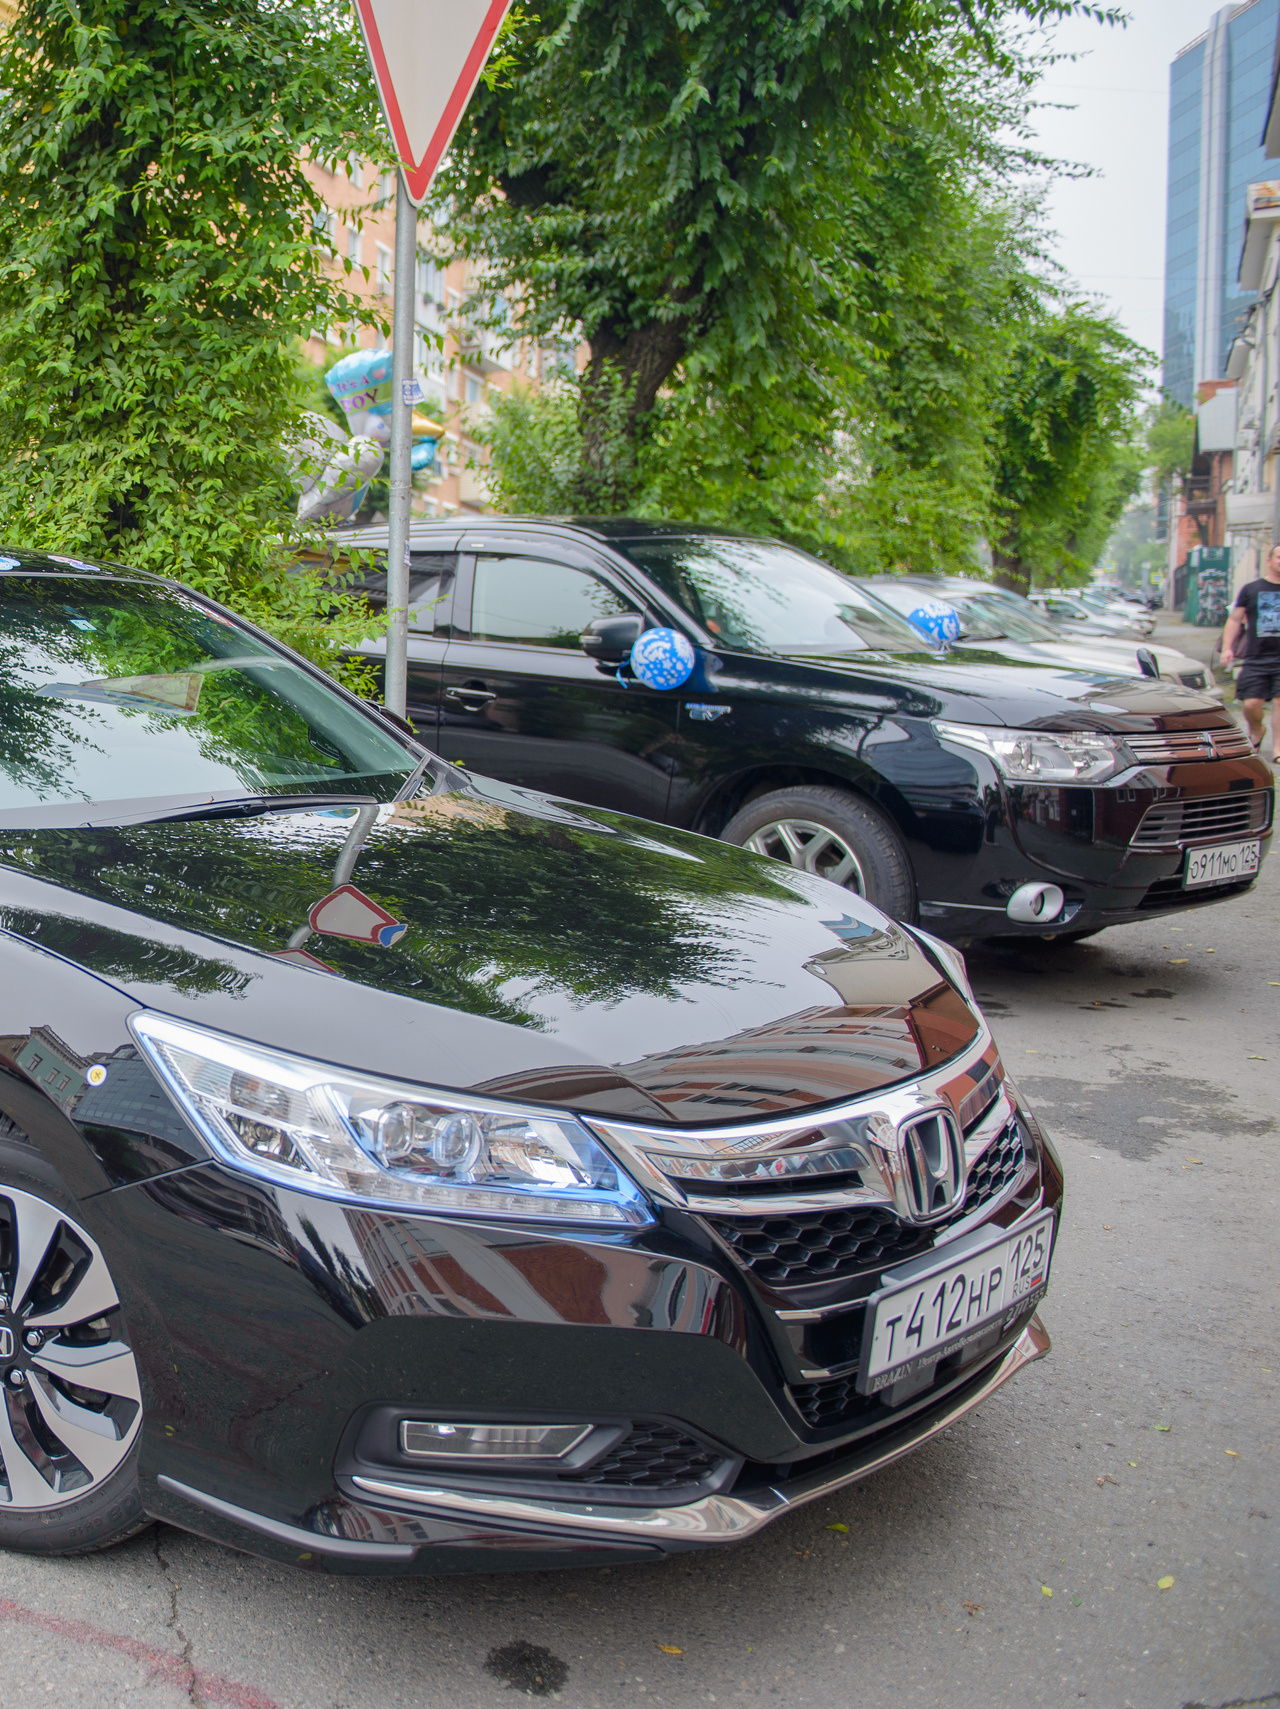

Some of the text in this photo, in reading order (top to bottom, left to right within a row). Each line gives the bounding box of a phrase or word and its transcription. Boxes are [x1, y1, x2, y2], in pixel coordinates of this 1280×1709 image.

[361, 374, 370, 386] A
[340, 388, 379, 412] BOY
[1240, 844, 1257, 864] 125
[885, 1225, 1046, 1362] Т412НР 125
[1012, 1274, 1031, 1299] RUS
